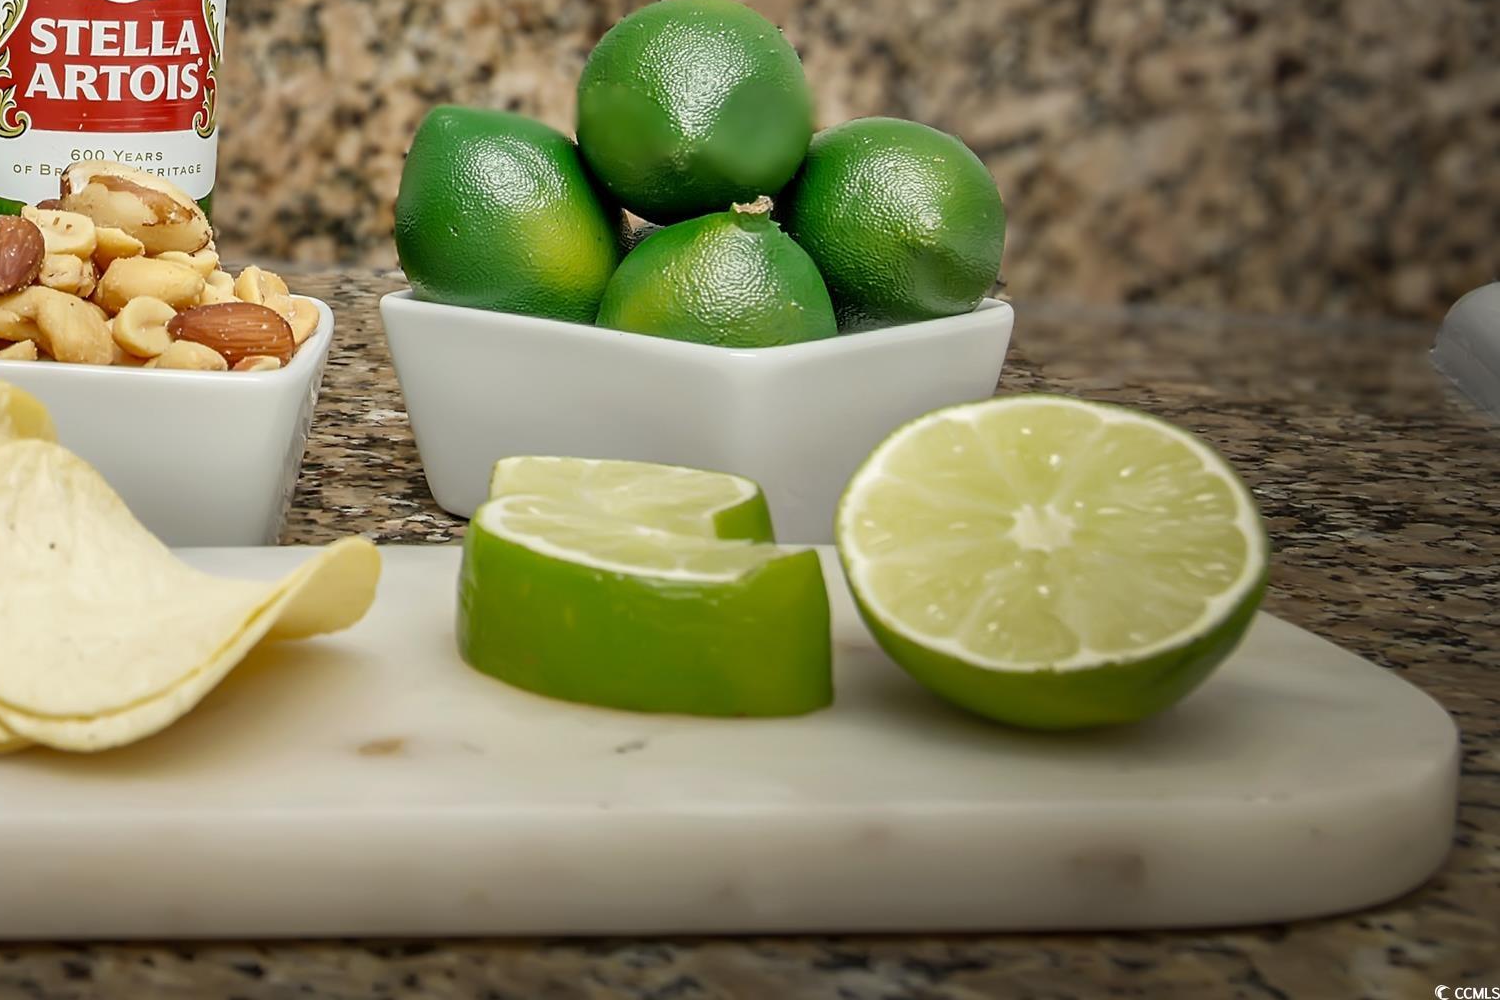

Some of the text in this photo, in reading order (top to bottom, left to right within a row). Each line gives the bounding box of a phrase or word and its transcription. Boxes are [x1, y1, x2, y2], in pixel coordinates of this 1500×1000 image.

[30, 17, 200, 57] STELLA
[24, 62, 199, 101] ARTOIS
[70, 149, 163, 162] 600 YEARS
[13, 164, 33, 174] OF
